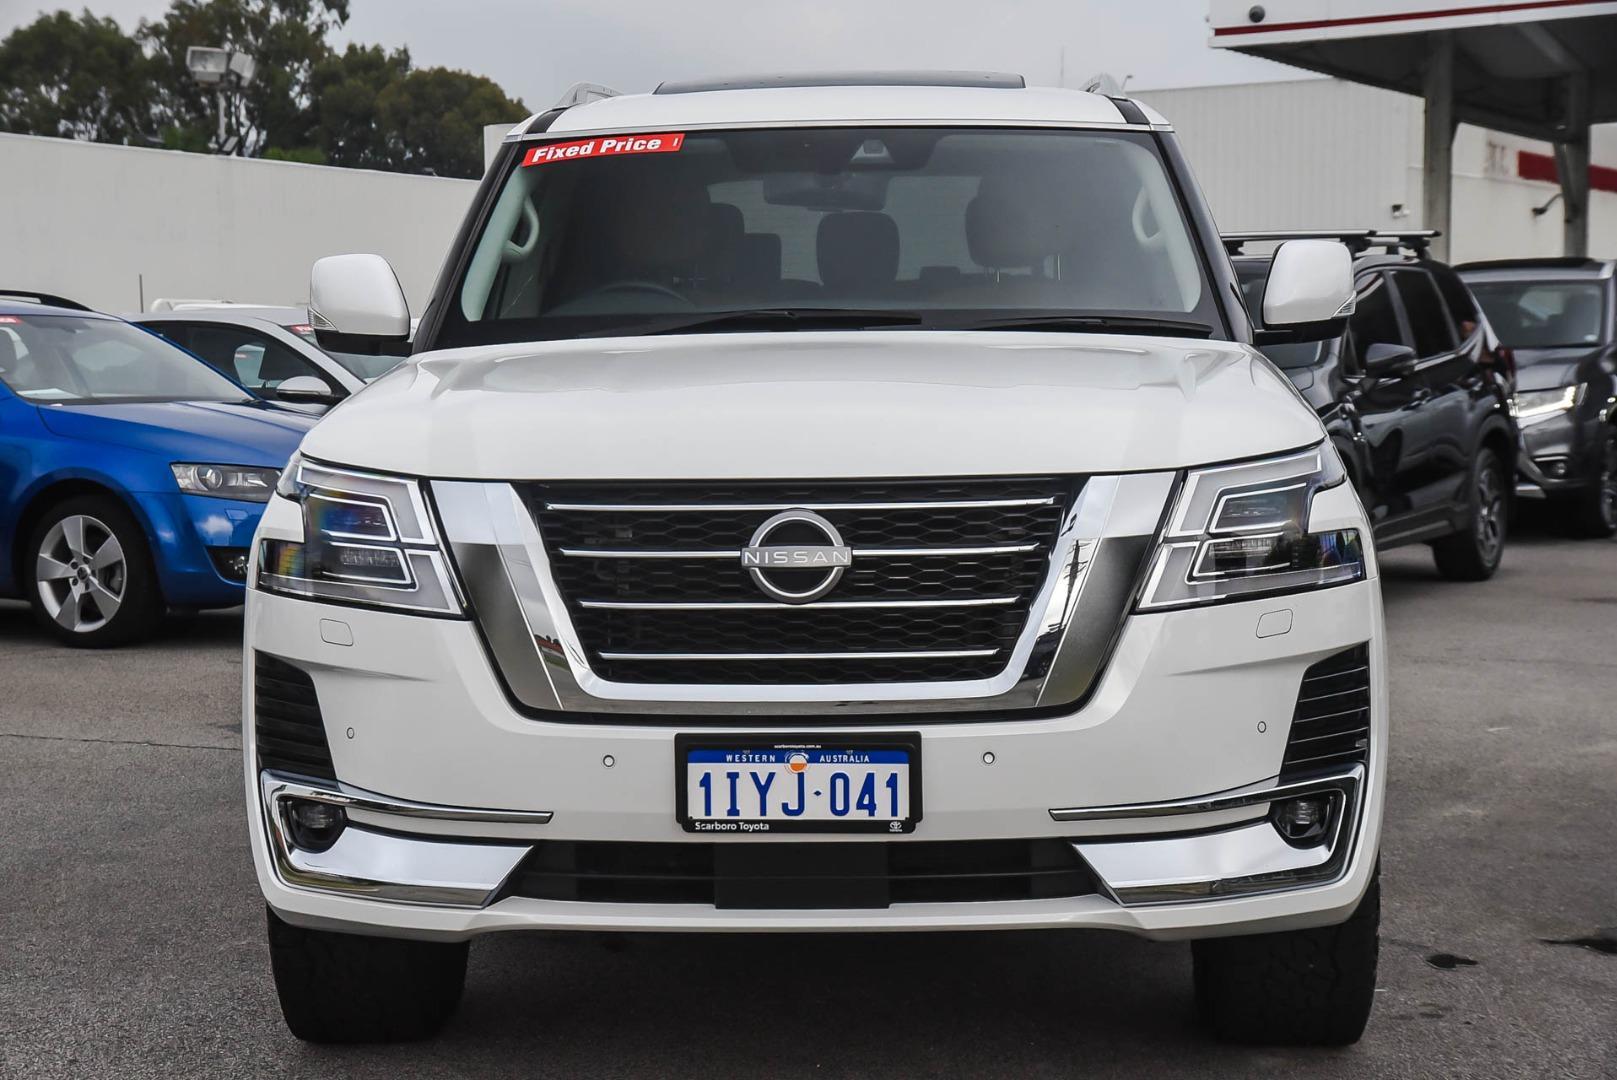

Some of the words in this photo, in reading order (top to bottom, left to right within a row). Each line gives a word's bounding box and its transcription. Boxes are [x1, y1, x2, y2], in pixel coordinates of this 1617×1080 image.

[531, 142, 595, 162] Fixed
[600, 138, 662, 153] Price
[744, 551, 848, 564] NISSAN
[725, 754, 776, 763] WESTERN
[819, 754, 870, 763] AUSTRALIA
[695, 821, 737, 830] Scarboro
[738, 821, 770, 832] Toyota
